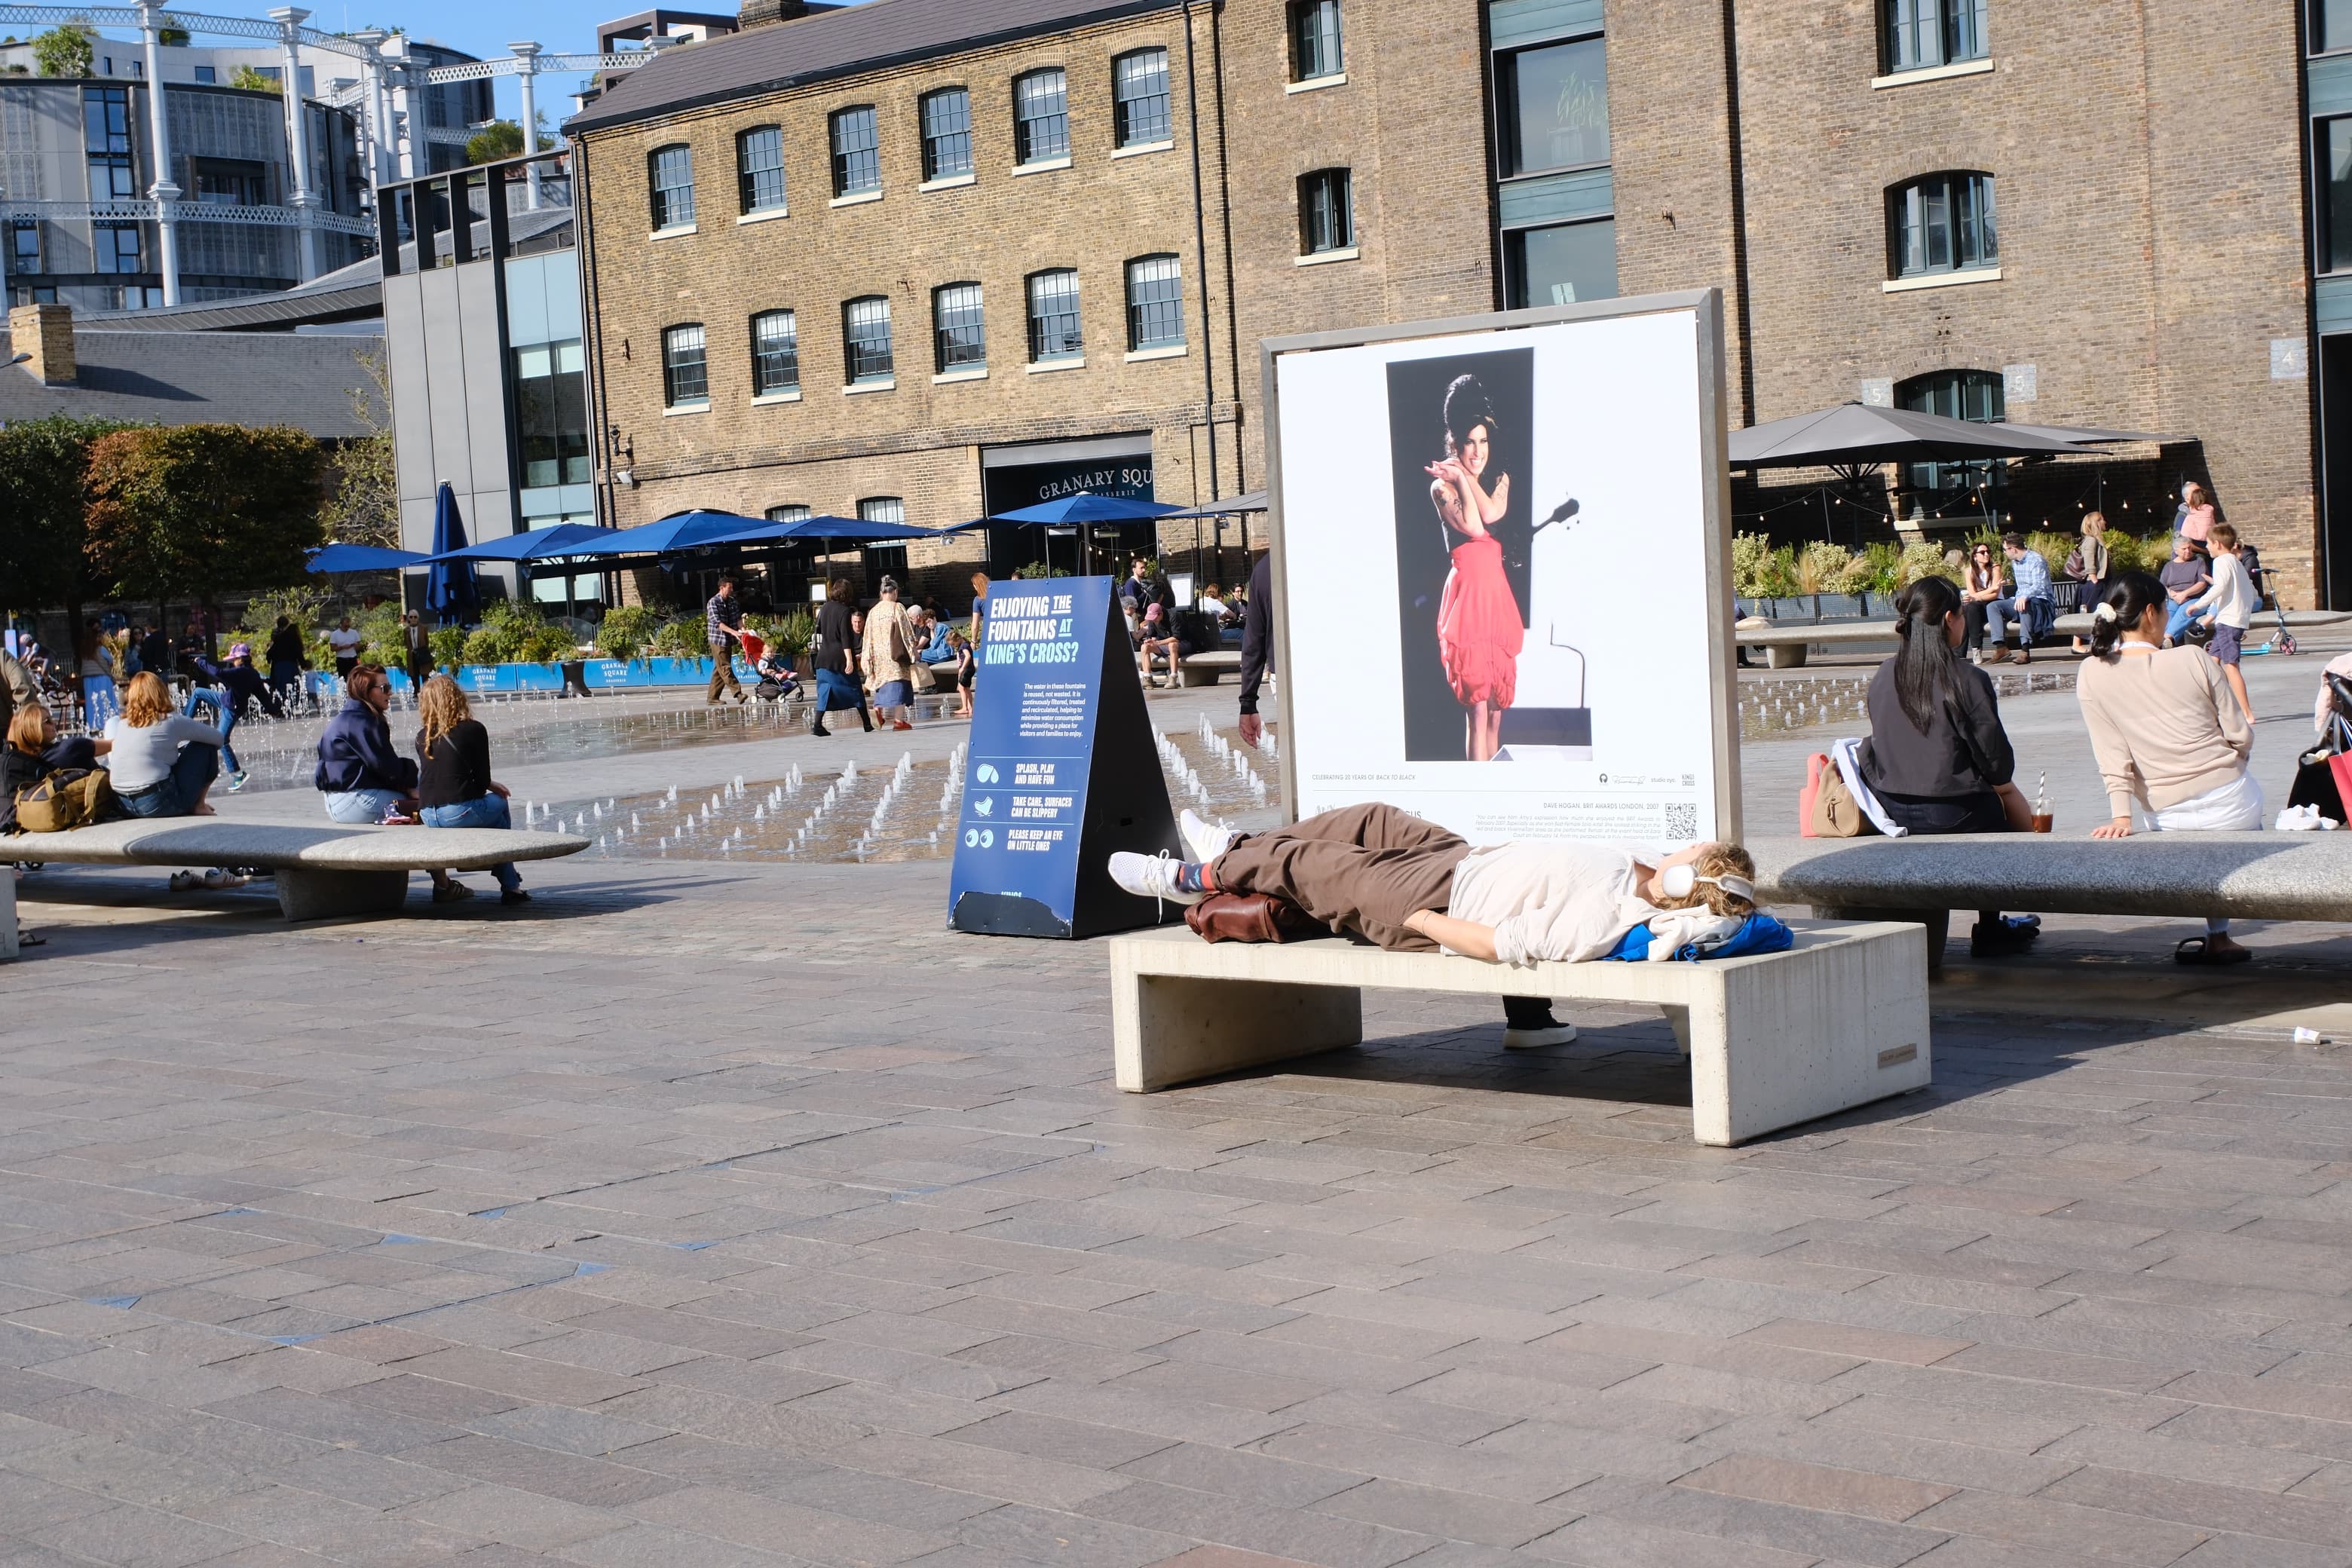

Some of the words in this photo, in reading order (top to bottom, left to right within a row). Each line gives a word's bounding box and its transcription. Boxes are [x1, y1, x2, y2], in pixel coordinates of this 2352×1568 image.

[1873, 388, 1882, 403] 5
[1040, 470, 1115, 499] GRANARY
[991, 596, 1049, 618] ENJOYING
[1053, 595, 1073, 610] THE
[988, 619, 1057, 642] FOUNTAINS
[1059, 618, 1073, 632] AT
[1030, 642, 1079, 663] CROSS?
[1015, 764, 1040, 775] SPLASH,
[1040, 764, 1055, 773] PLAY
[1015, 775, 1027, 785] AND
[1027, 775, 1043, 785] HAVE
[1043, 775, 1055, 785] FUN
[1012, 797, 1027, 807] TAKE
[1027, 797, 1044, 808] CARE,
[1044, 798, 1073, 807] SURFACES
[1011, 807, 1024, 817] CAN
[1024, 808, 1031, 817] BE
[1031, 808, 1058, 818] SLIPPERY
[1008, 829, 1029, 840] PLEASE
[1029, 830, 1043, 840] KEEP
[1043, 830, 1052, 840] AN
[1052, 831, 1064, 841] EYE
[1007, 840, 1015, 850] ON
[1015, 841, 1036, 850] LITTLE
[1036, 841, 1051, 851] ONES
